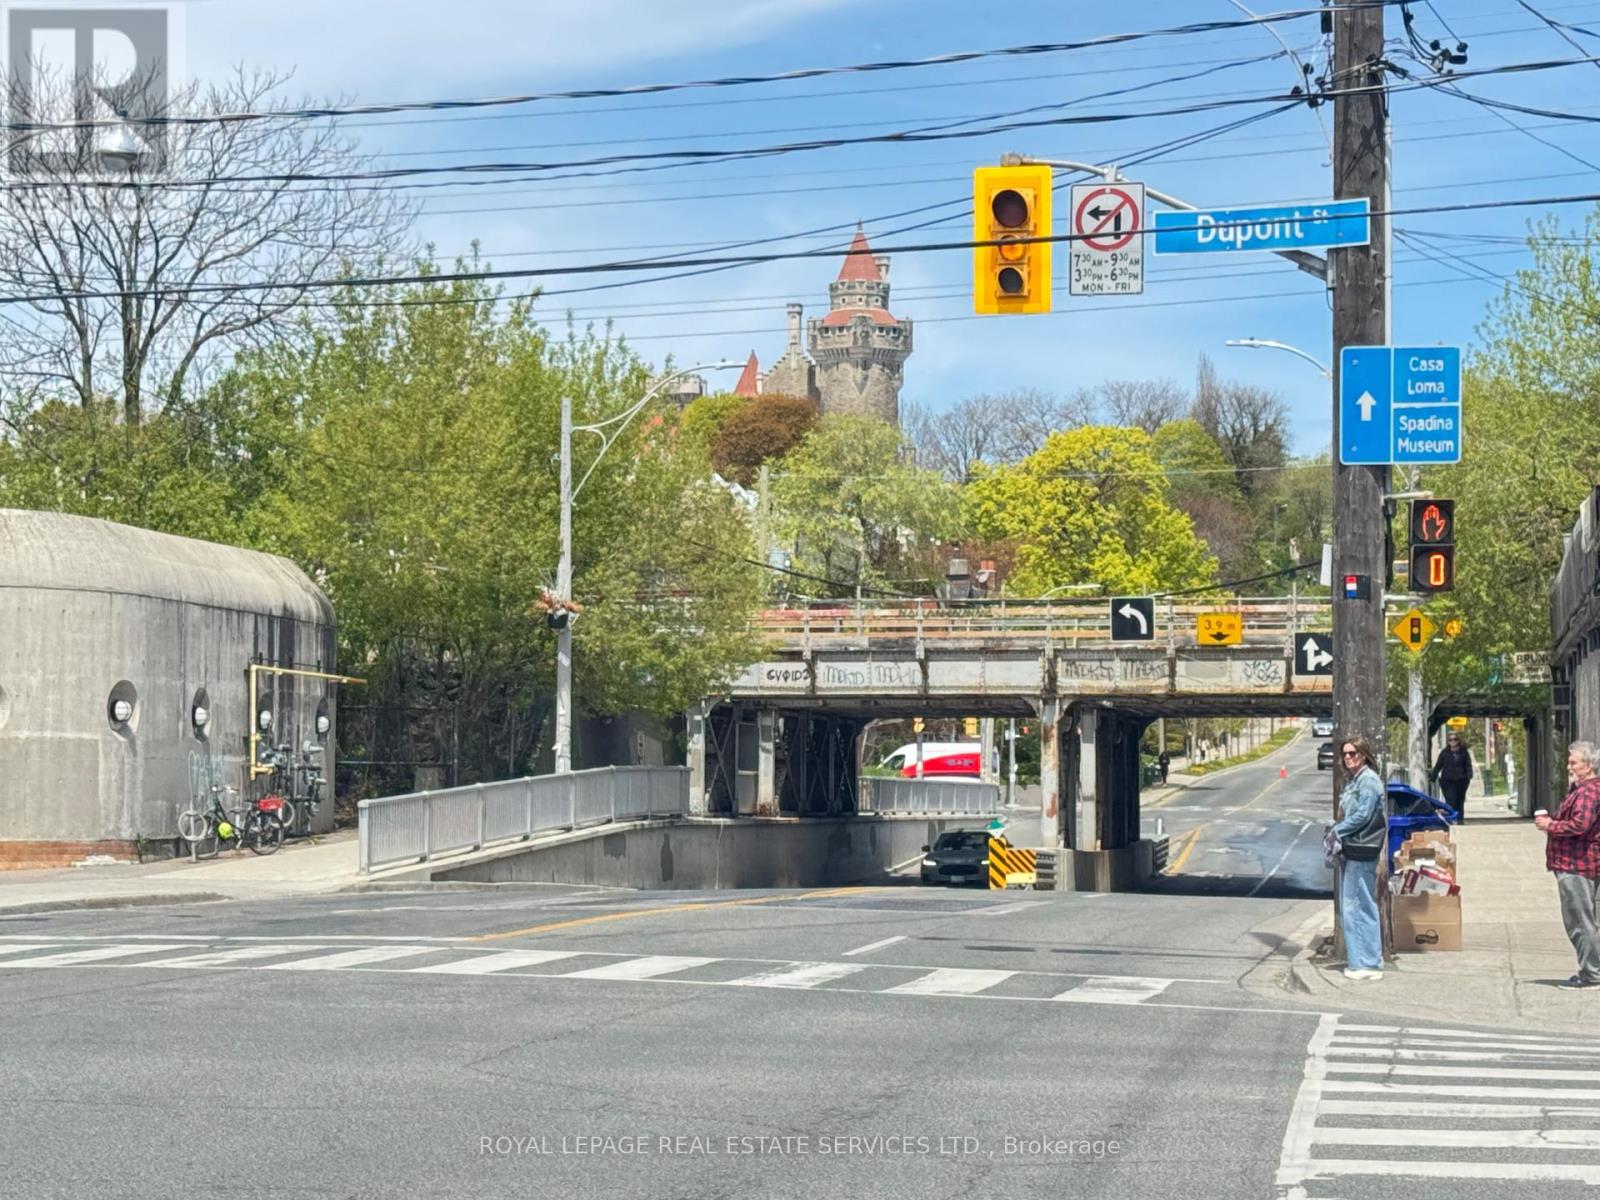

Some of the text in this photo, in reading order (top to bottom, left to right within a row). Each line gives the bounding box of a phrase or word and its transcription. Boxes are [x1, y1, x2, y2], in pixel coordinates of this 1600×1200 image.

[1197, 209, 1329, 249] Dupont St
[1082, 283, 1104, 293] MON
[1115, 282, 1131, 292] FRI
[1408, 356, 1444, 372] Casa
[1407, 379, 1445, 395] Loma
[1399, 415, 1453, 434] Spadina
[1398, 437, 1454, 454] Museum
[1429, 554, 1445, 586] 0
